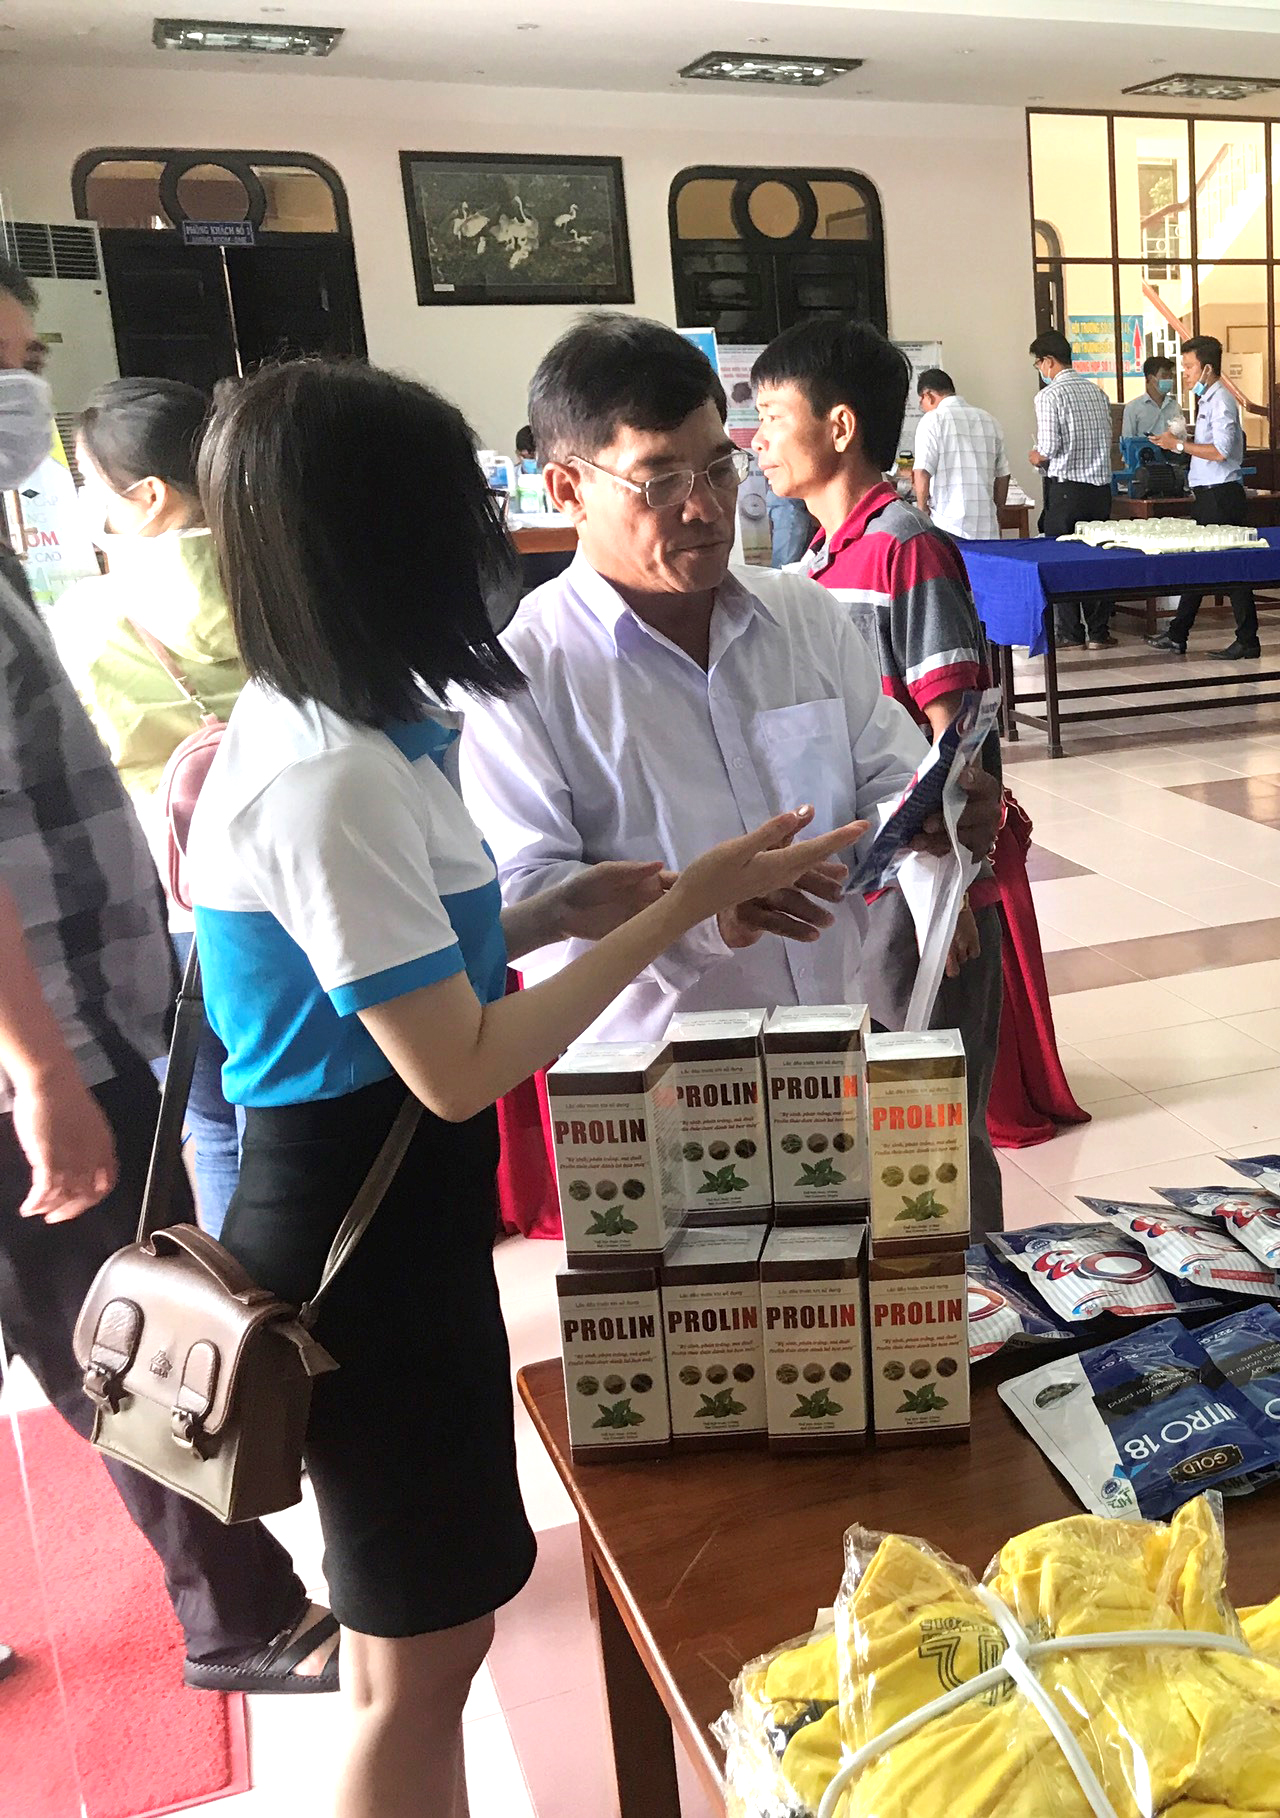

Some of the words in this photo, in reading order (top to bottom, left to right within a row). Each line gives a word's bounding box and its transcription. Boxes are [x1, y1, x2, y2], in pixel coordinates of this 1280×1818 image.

[771, 1074, 858, 1100] PROLIN
[873, 1103, 963, 1131] PROLIN
[554, 1118, 647, 1144] PROLIN
[667, 1306, 758, 1333] PROLIN
[766, 1303, 855, 1330] PROLIN
[874, 1299, 962, 1327] PROLIN
[563, 1315, 655, 1342] PROLIN
[1107, 1392, 1135, 1409] pond
[1124, 1434, 1161, 1460] 18
[1182, 1452, 1229, 1474] GOLD
